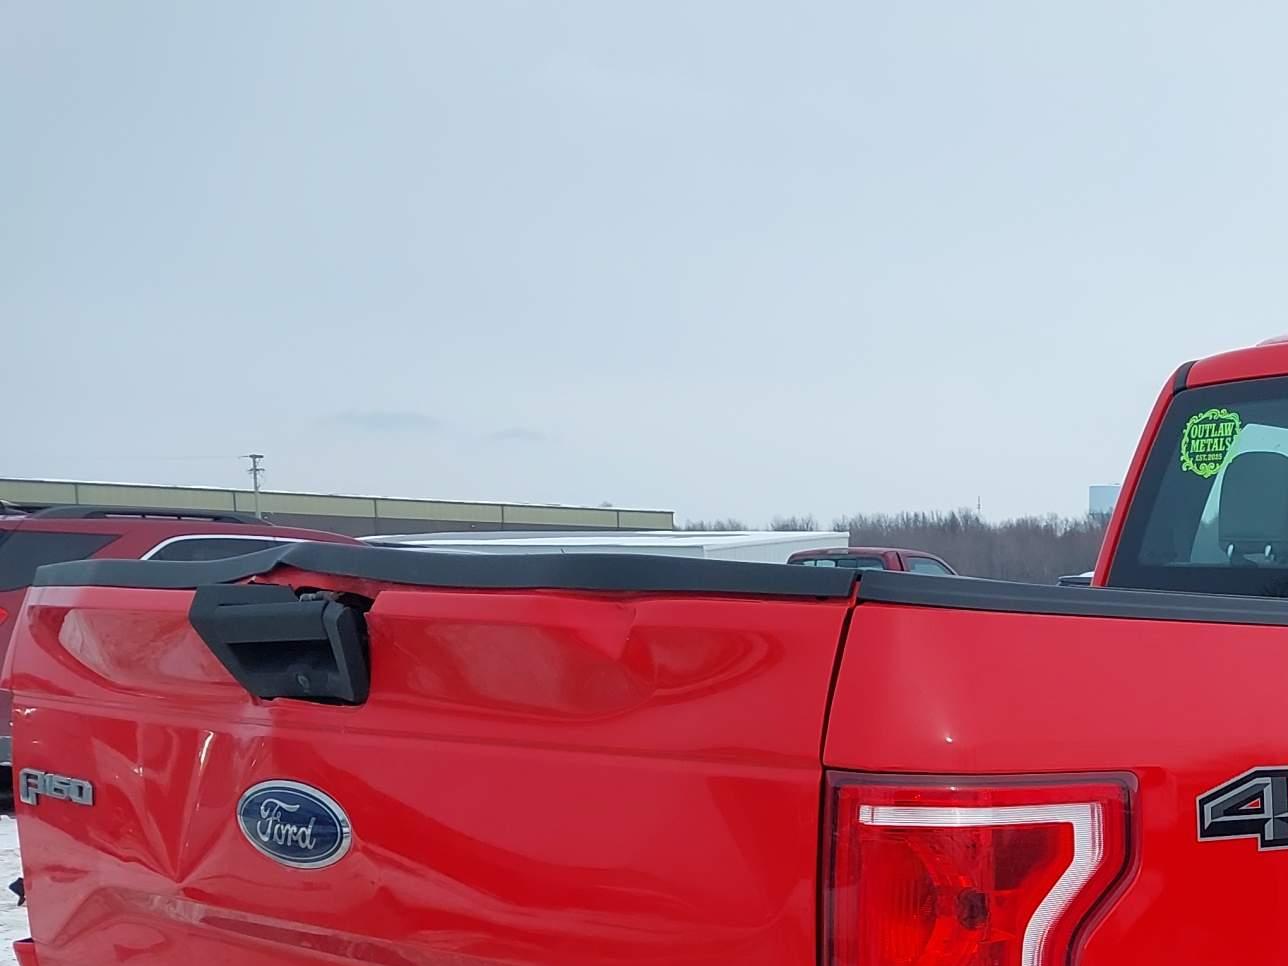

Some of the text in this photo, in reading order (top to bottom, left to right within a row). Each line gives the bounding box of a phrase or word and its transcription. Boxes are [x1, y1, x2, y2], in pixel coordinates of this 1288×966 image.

[1191, 422, 1234, 438] OUTLAW
[1190, 437, 1232, 453] METALS
[256, 798, 317, 849] Ford
